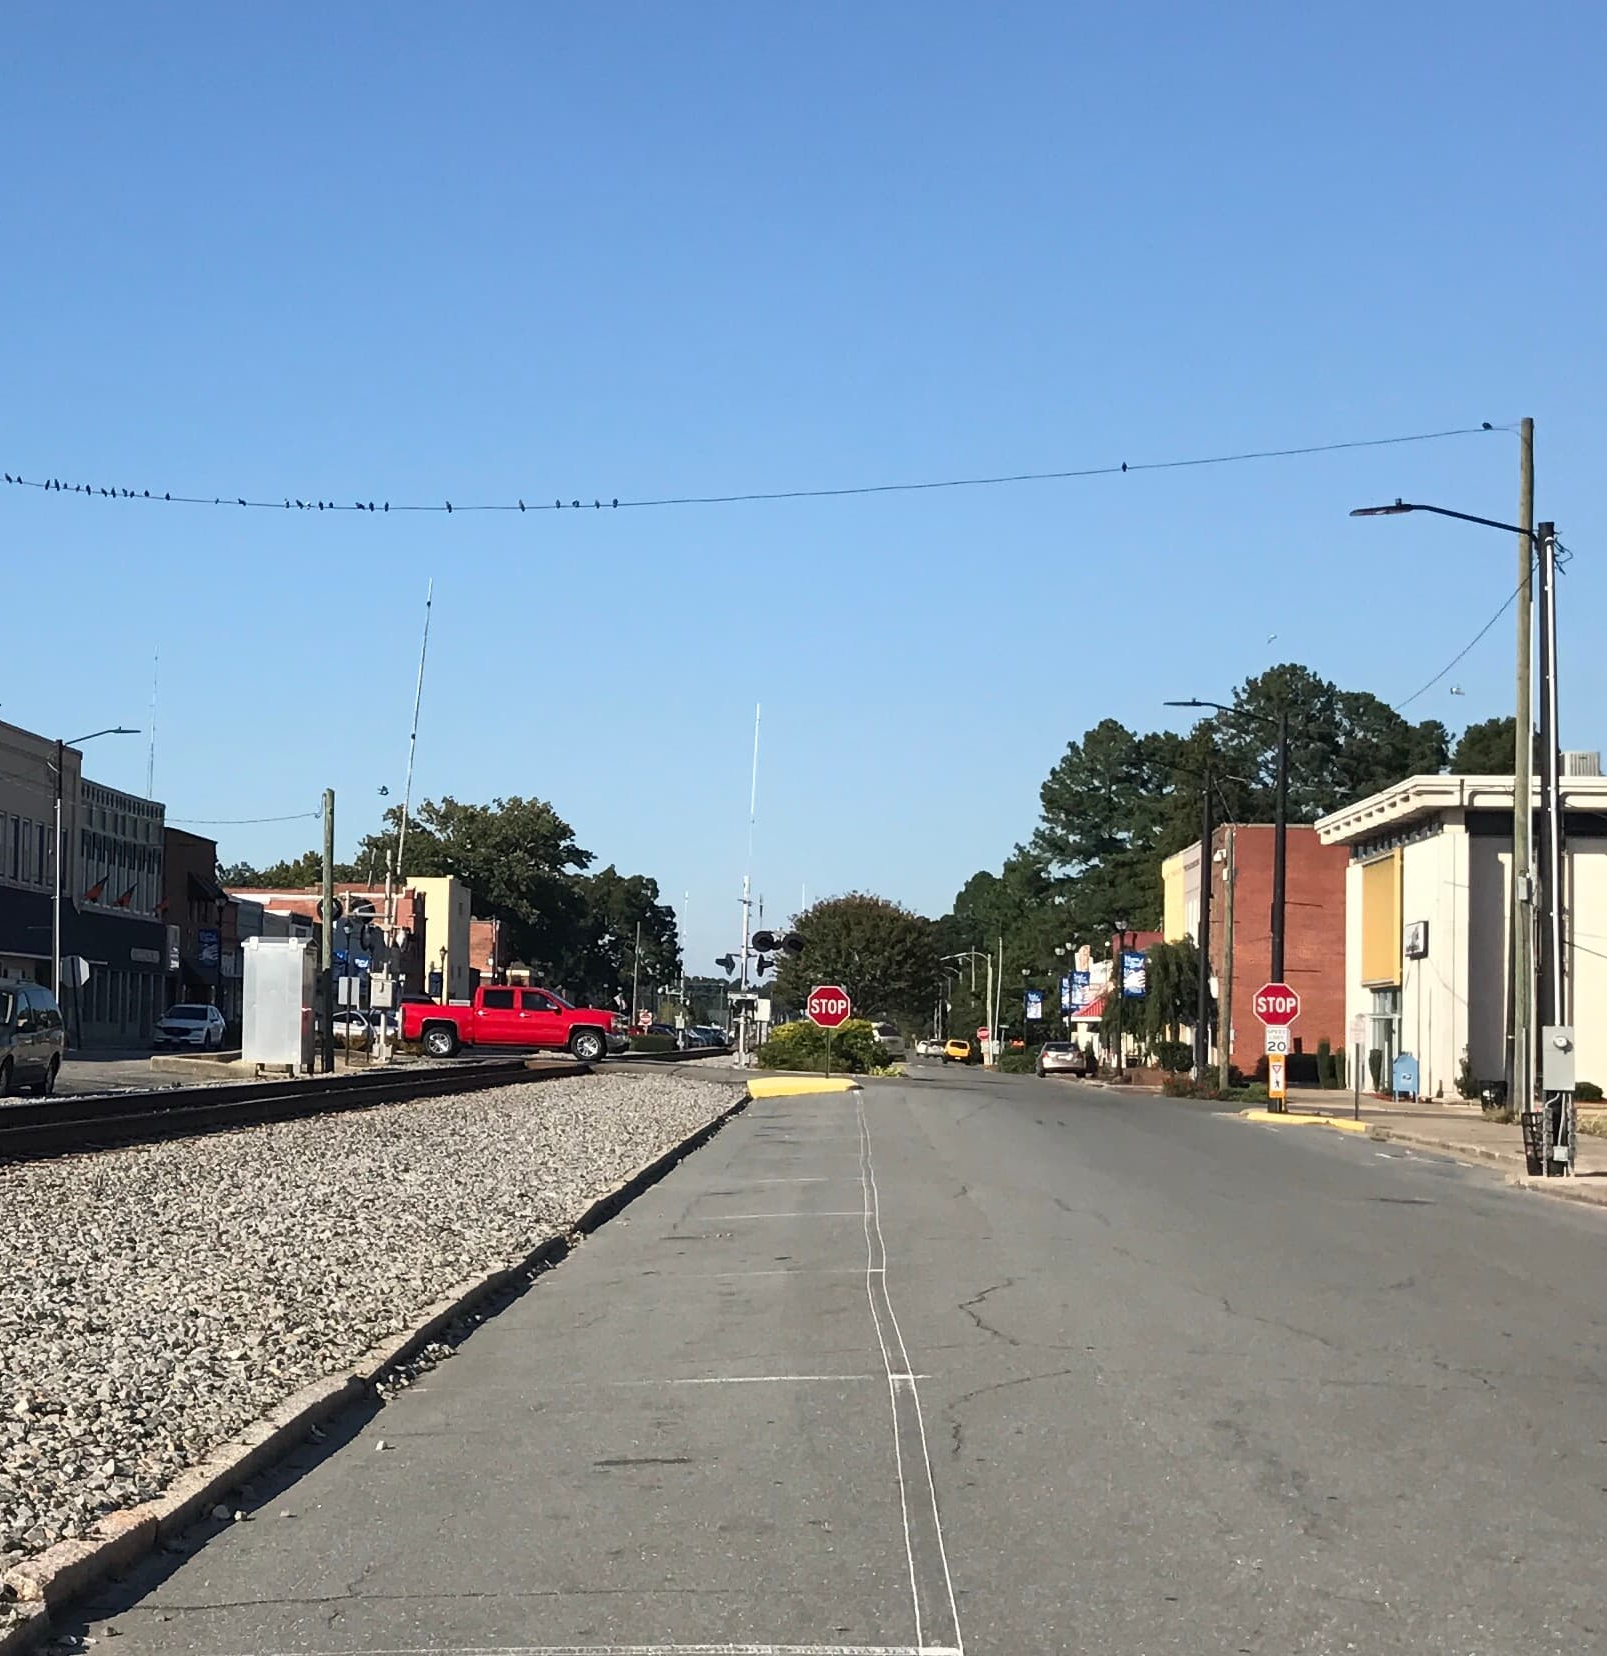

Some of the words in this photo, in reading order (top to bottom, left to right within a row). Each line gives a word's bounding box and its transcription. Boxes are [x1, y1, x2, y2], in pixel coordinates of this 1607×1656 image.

[810, 998, 847, 1015] STOP
[1257, 997, 1297, 1014] STOP
[1267, 1041, 1287, 1052] 20
